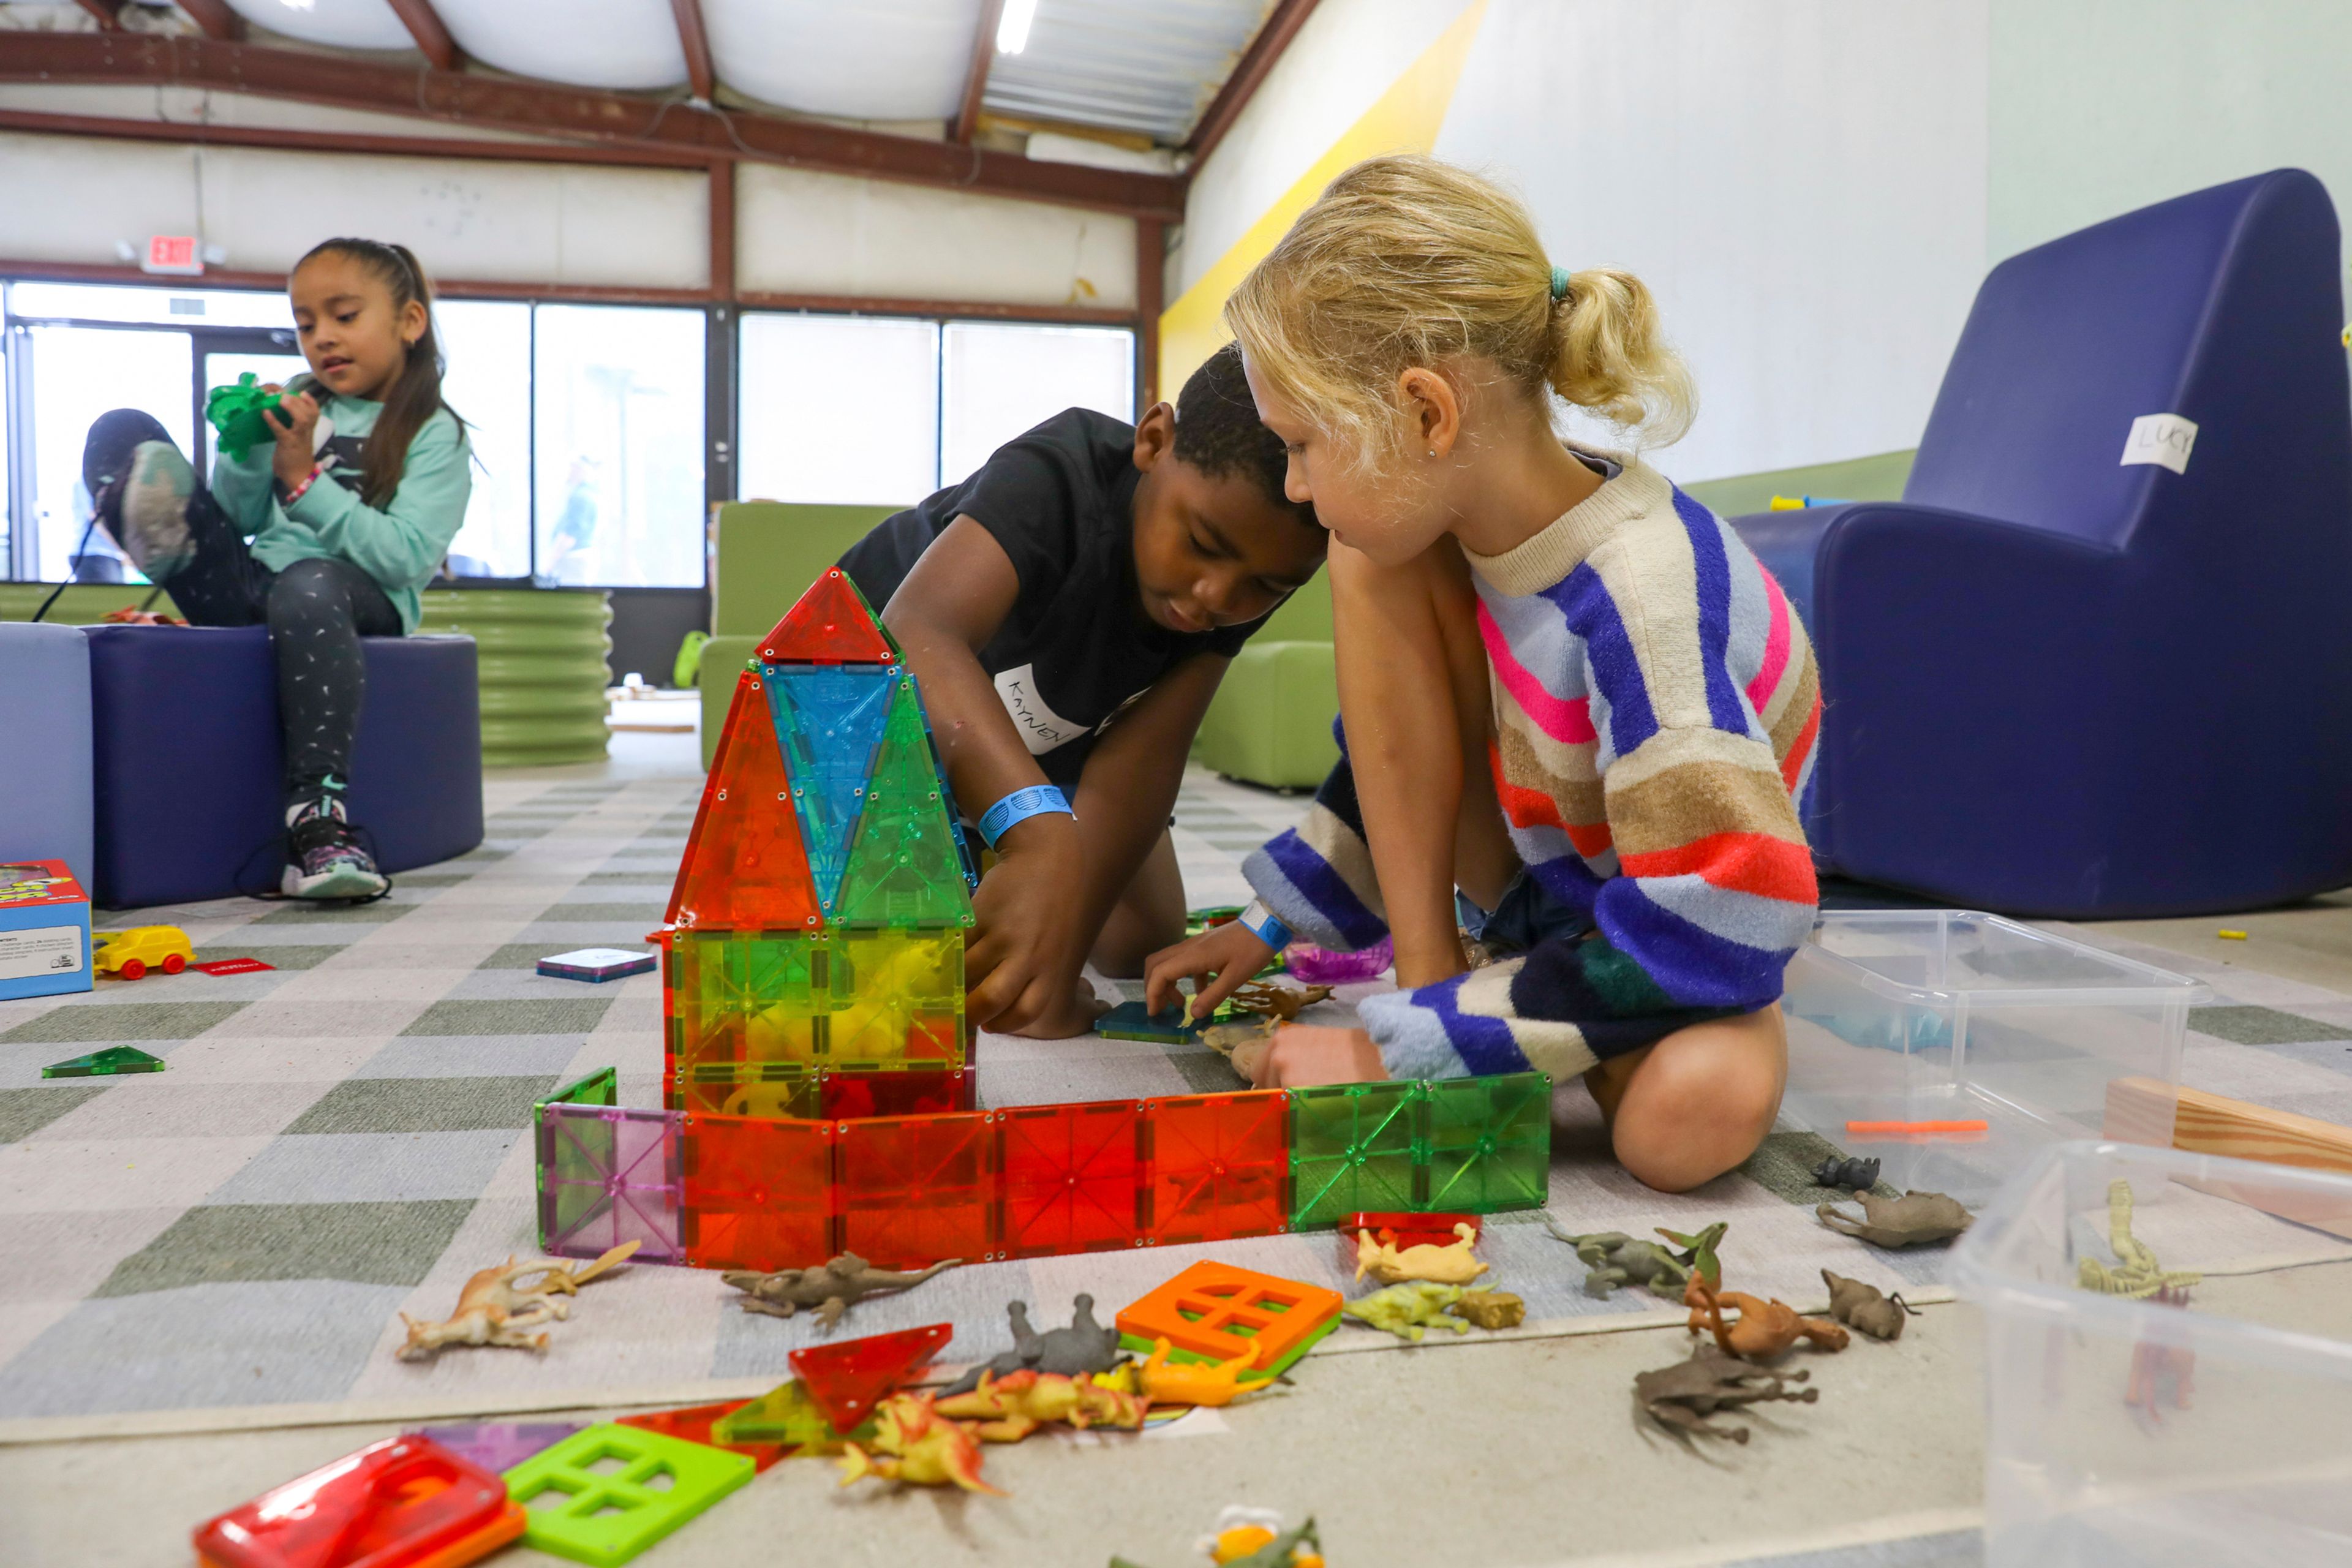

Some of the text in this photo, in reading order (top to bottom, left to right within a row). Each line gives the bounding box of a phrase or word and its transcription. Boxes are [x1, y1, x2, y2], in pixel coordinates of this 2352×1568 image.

[149, 235, 196, 267] EXIT
[2138, 423, 2193, 454] LUCY
[1009, 680, 1071, 742] KAYNEN
